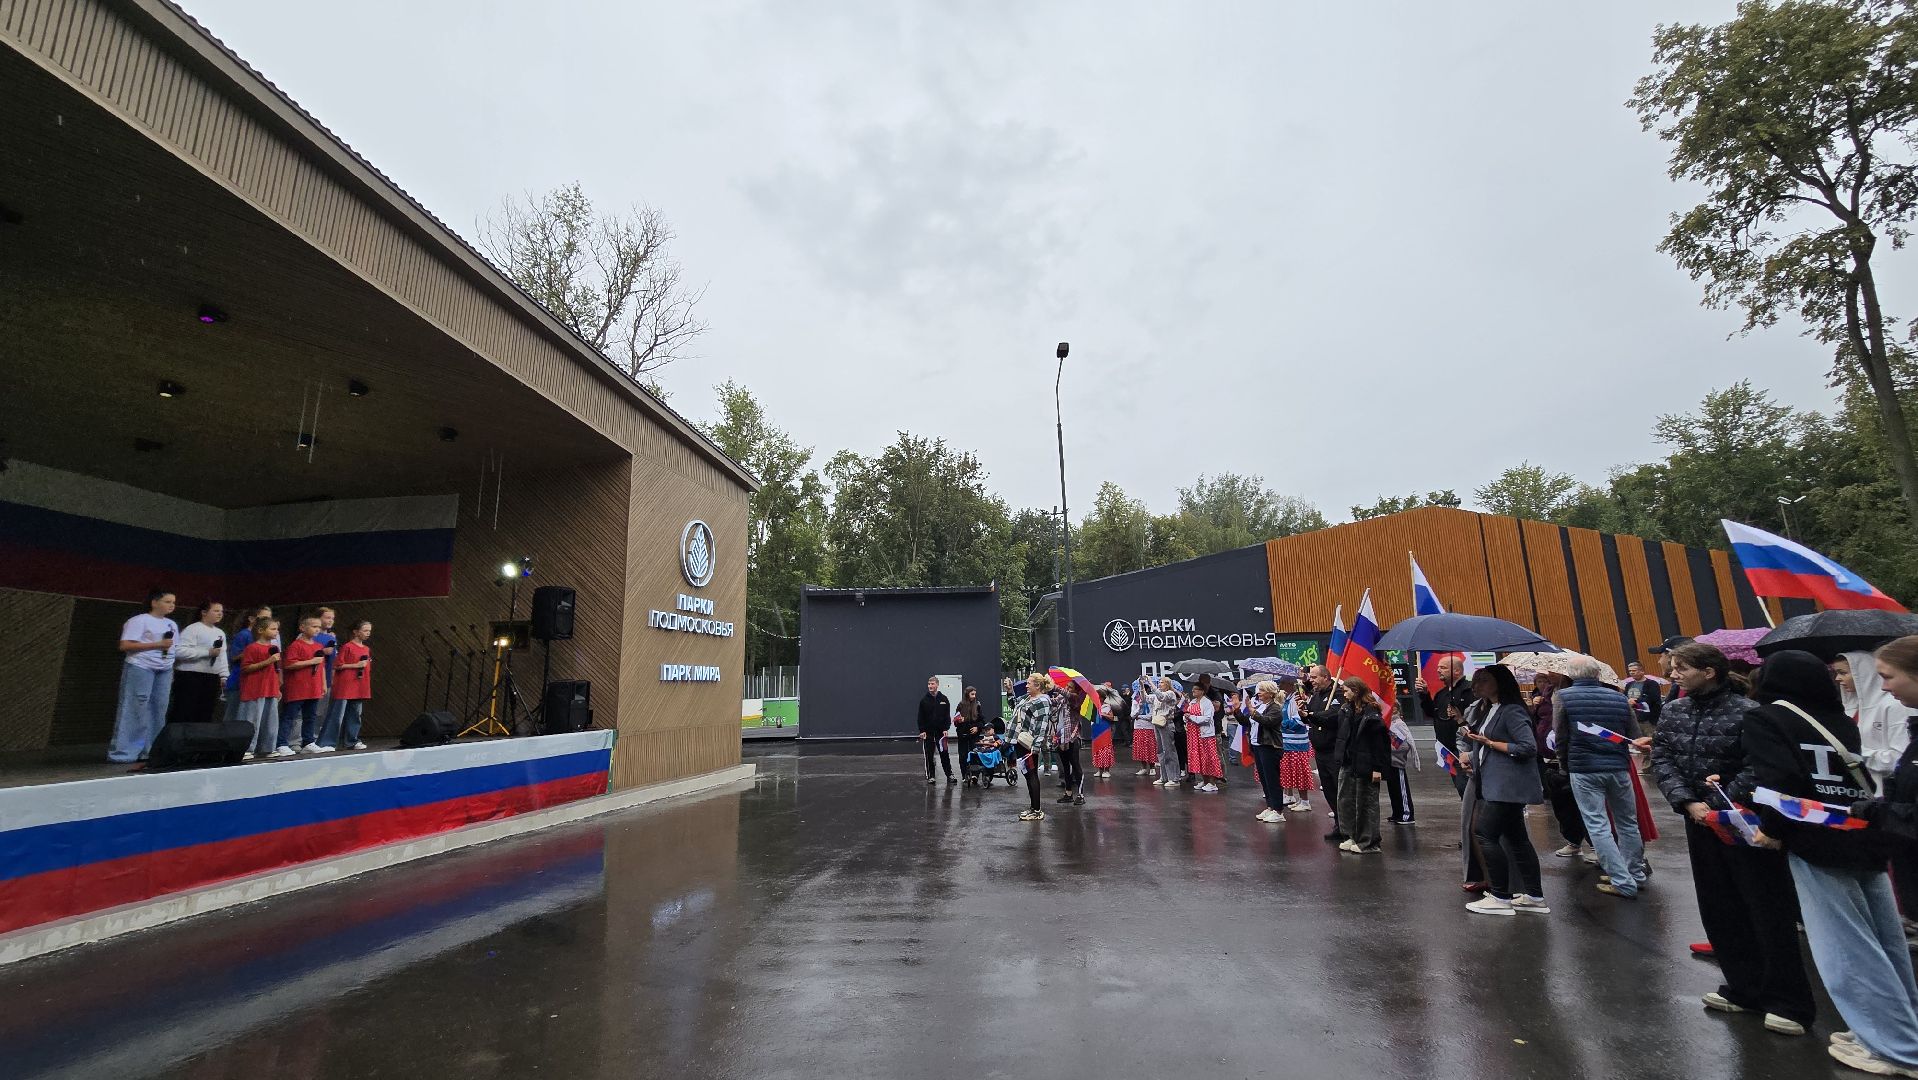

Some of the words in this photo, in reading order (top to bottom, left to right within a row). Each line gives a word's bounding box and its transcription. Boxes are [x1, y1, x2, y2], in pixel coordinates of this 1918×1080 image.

[677, 593, 713, 615] ПАРКИ
[648, 610, 734, 637] ПОДМОСКОВЬЯ
[1138, 618, 1195, 633] ПАРКИ
[1138, 632, 1276, 649] ПОДМОСКОВЬЯ
[661, 664, 691, 680] ПАРК
[693, 665, 720, 681] МИРА
[1800, 743, 1843, 782] I
[1815, 783, 1868, 799] SUPPOR
